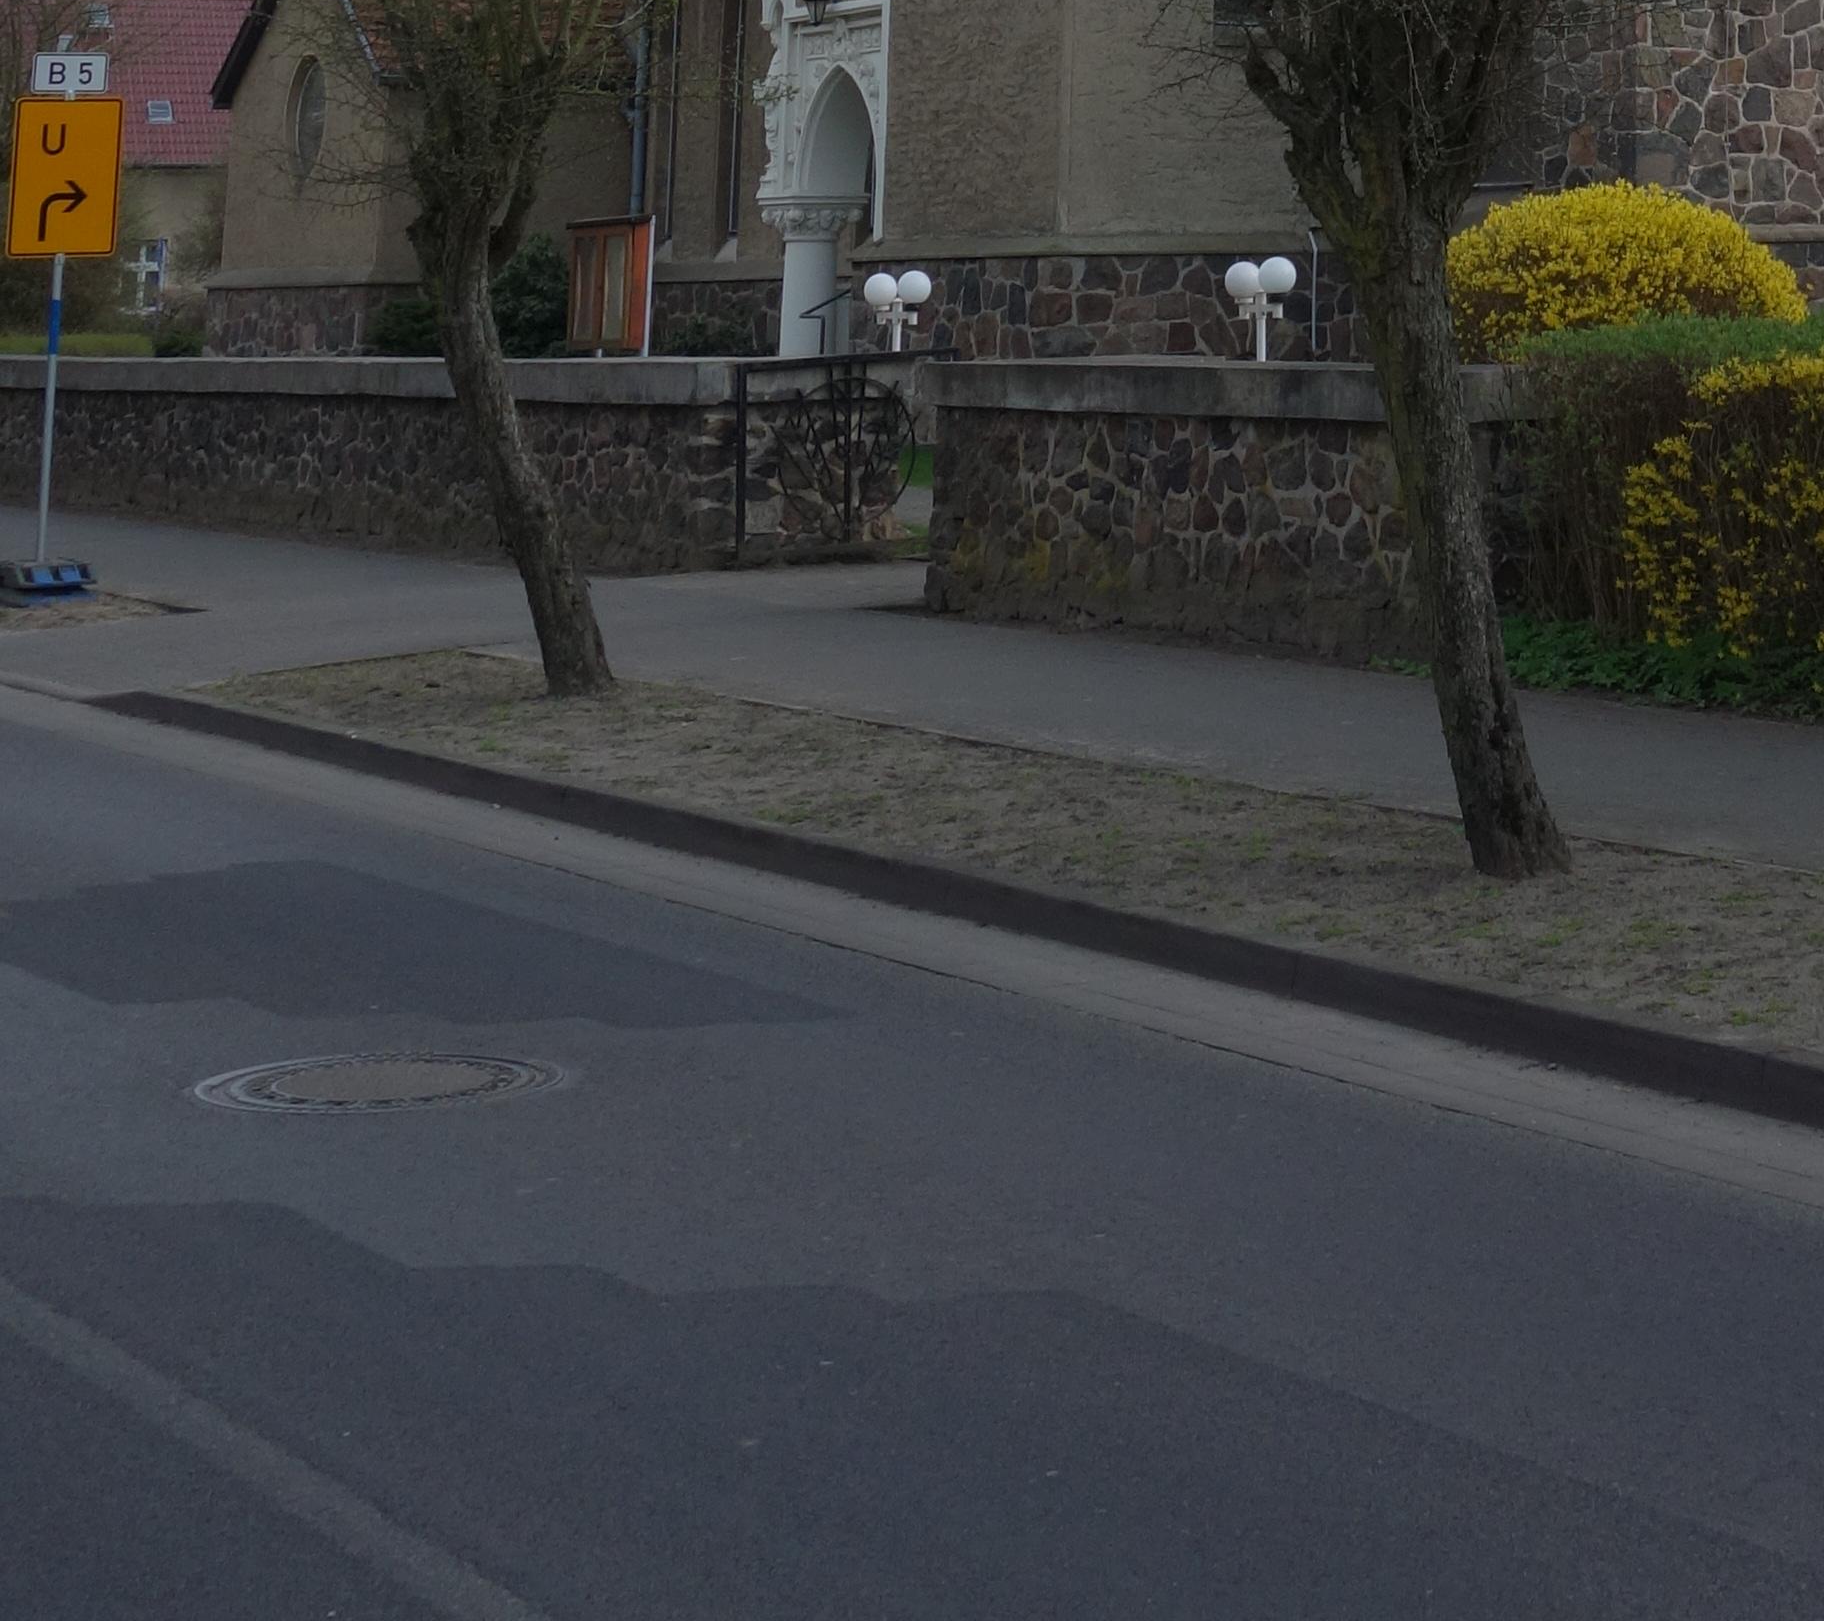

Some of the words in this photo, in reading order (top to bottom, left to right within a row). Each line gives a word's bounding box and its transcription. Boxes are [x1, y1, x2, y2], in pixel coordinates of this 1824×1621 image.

[48, 62, 66, 85] B
[78, 62, 93, 85] 5
[41, 123, 66, 156] U
